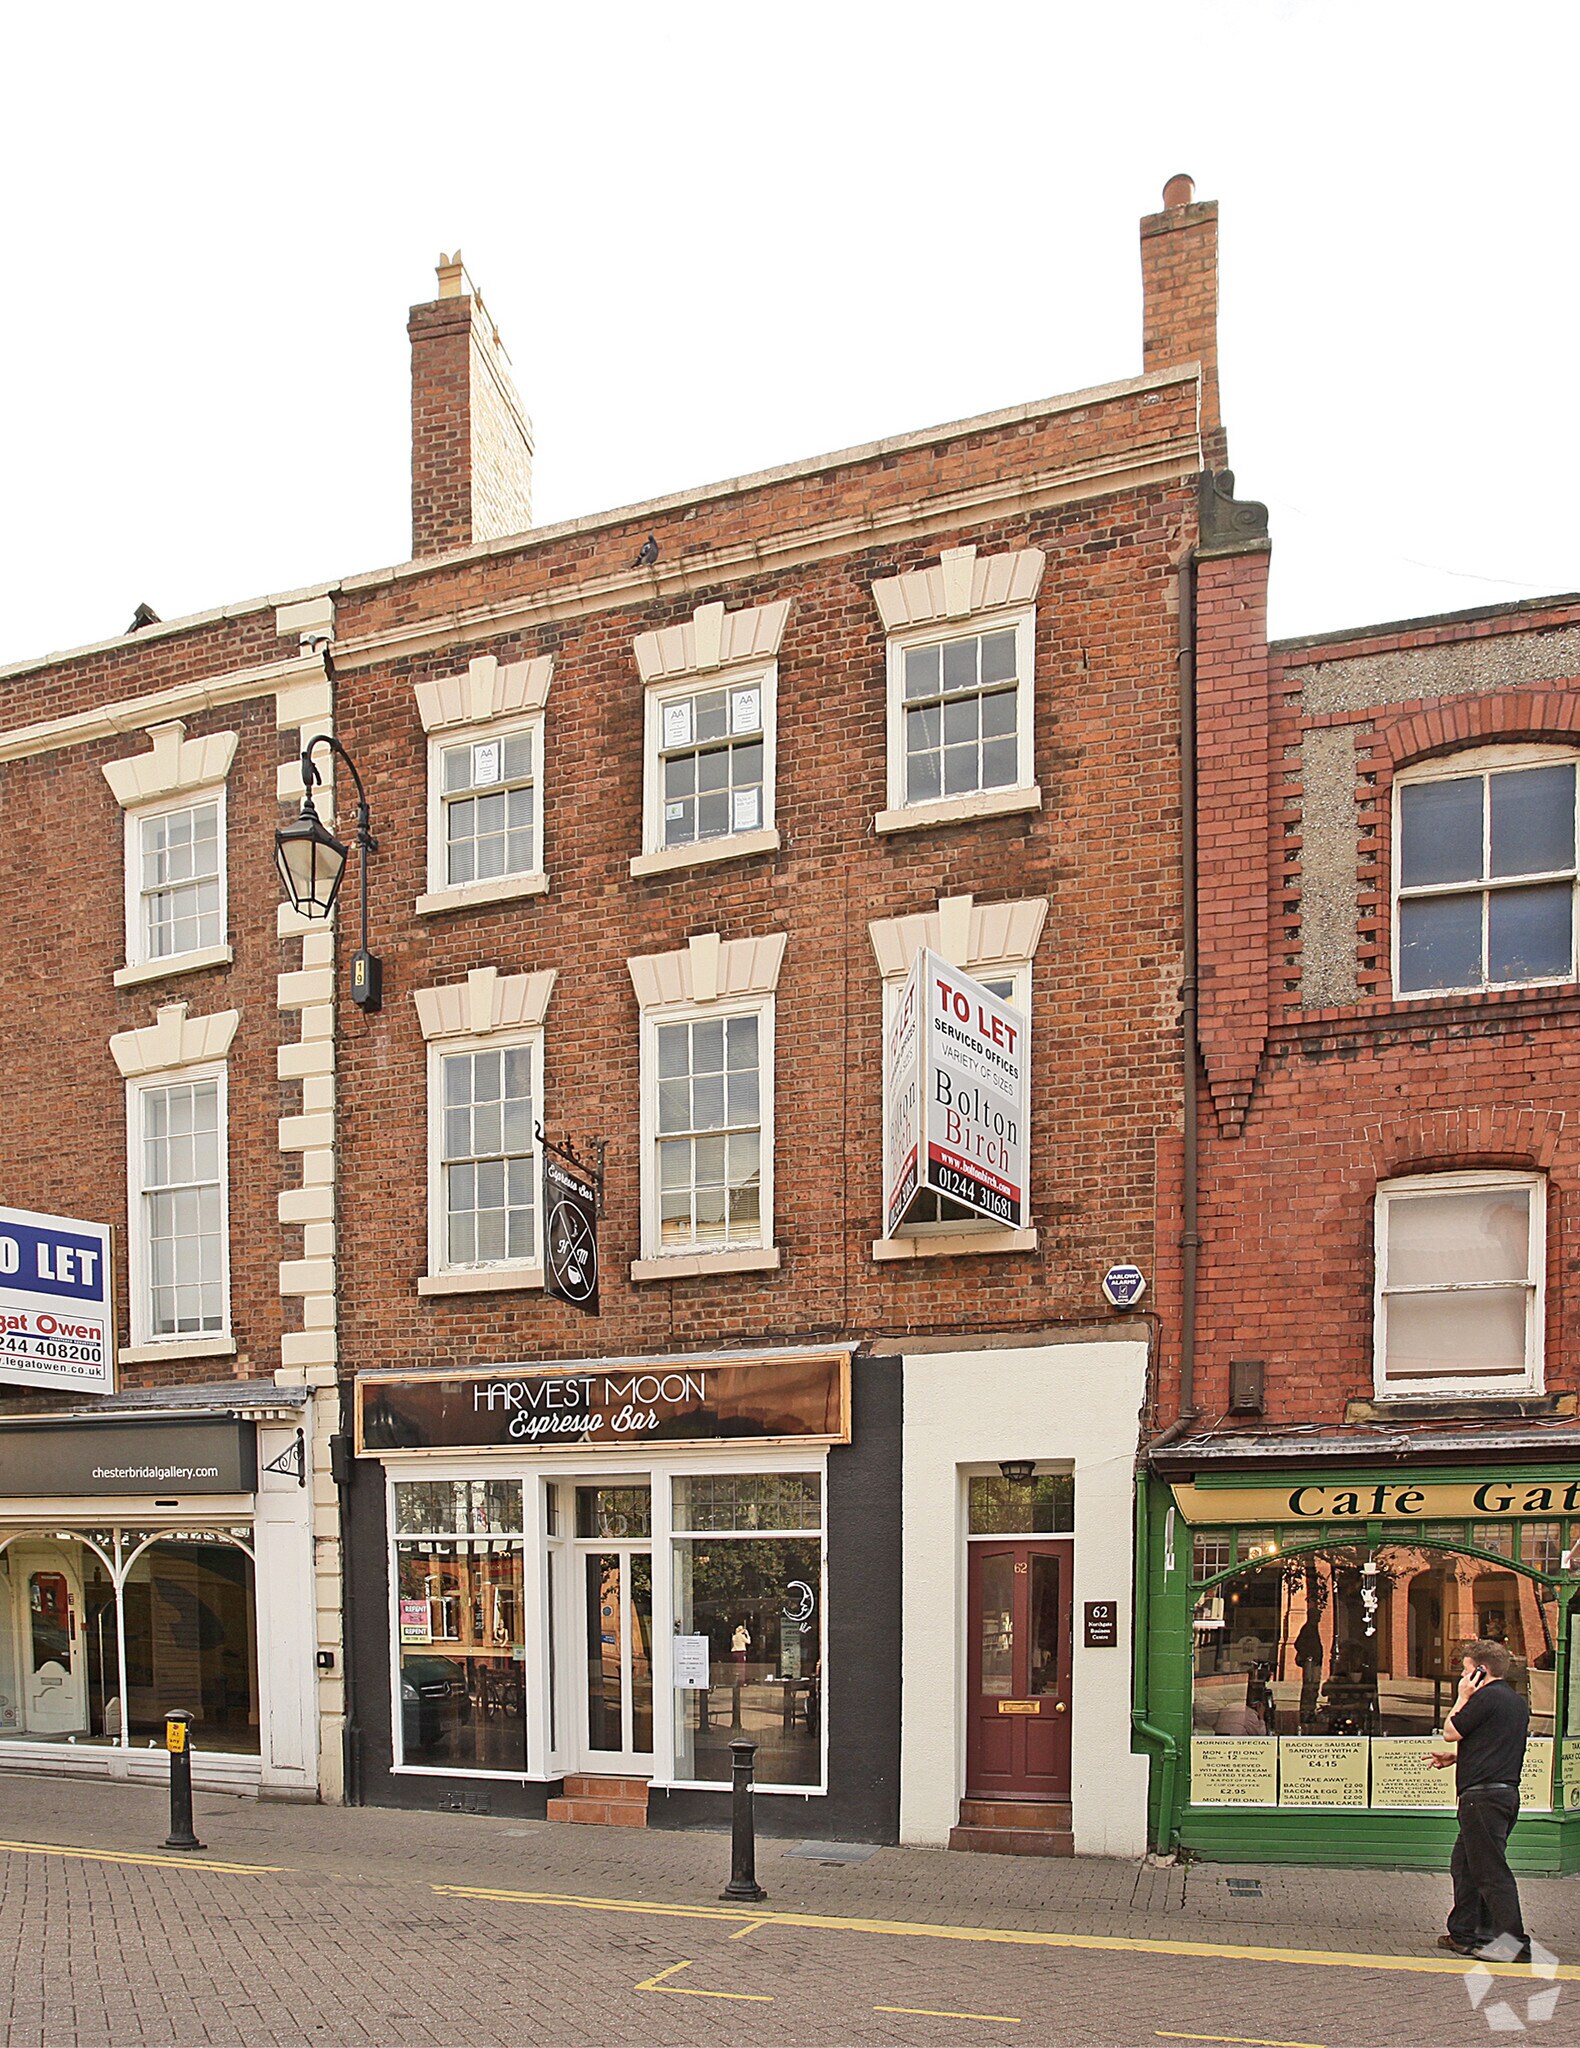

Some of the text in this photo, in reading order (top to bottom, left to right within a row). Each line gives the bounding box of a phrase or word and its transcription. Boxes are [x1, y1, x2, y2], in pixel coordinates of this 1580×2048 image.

[671, 709, 685, 719] AA
[739, 695, 754, 705] AA
[480, 749, 493, 758] AA
[937, 979, 1018, 1055] TO LET
[934, 1017, 1019, 1080] SERVICED OFFICES
[941, 1042, 979, 1070] VARIETY
[980, 1065, 992, 1080] OF
[992, 1072, 1014, 1096] SIZES
[934, 1067, 1018, 1146] Bolton
[945, 1107, 1010, 1174] Birch
[547, 1164, 594, 1201] Espresso Bar
[940, 1152, 1011, 1196] www.boltonbirch.com
[938, 1167, 975, 1201] 01244
[979, 1187, 1012, 1220] 311681
[37, 1242, 98, 1287] LET
[36, 1314, 101, 1340] Owen
[0, 1356, 102, 1376] .legatowen.co.uk
[35, 1341, 101, 1362] 408200
[474, 1372, 705, 1411] HARVEST MOON
[508, 1404, 660, 1440] Espresso Bar
[92, 1466, 218, 1480] chesterbridalgallery.com
[1288, 1484, 1425, 1516] Café
[1014, 1562, 1028, 1574] 62
[1092, 1606, 1108, 1618] 62
